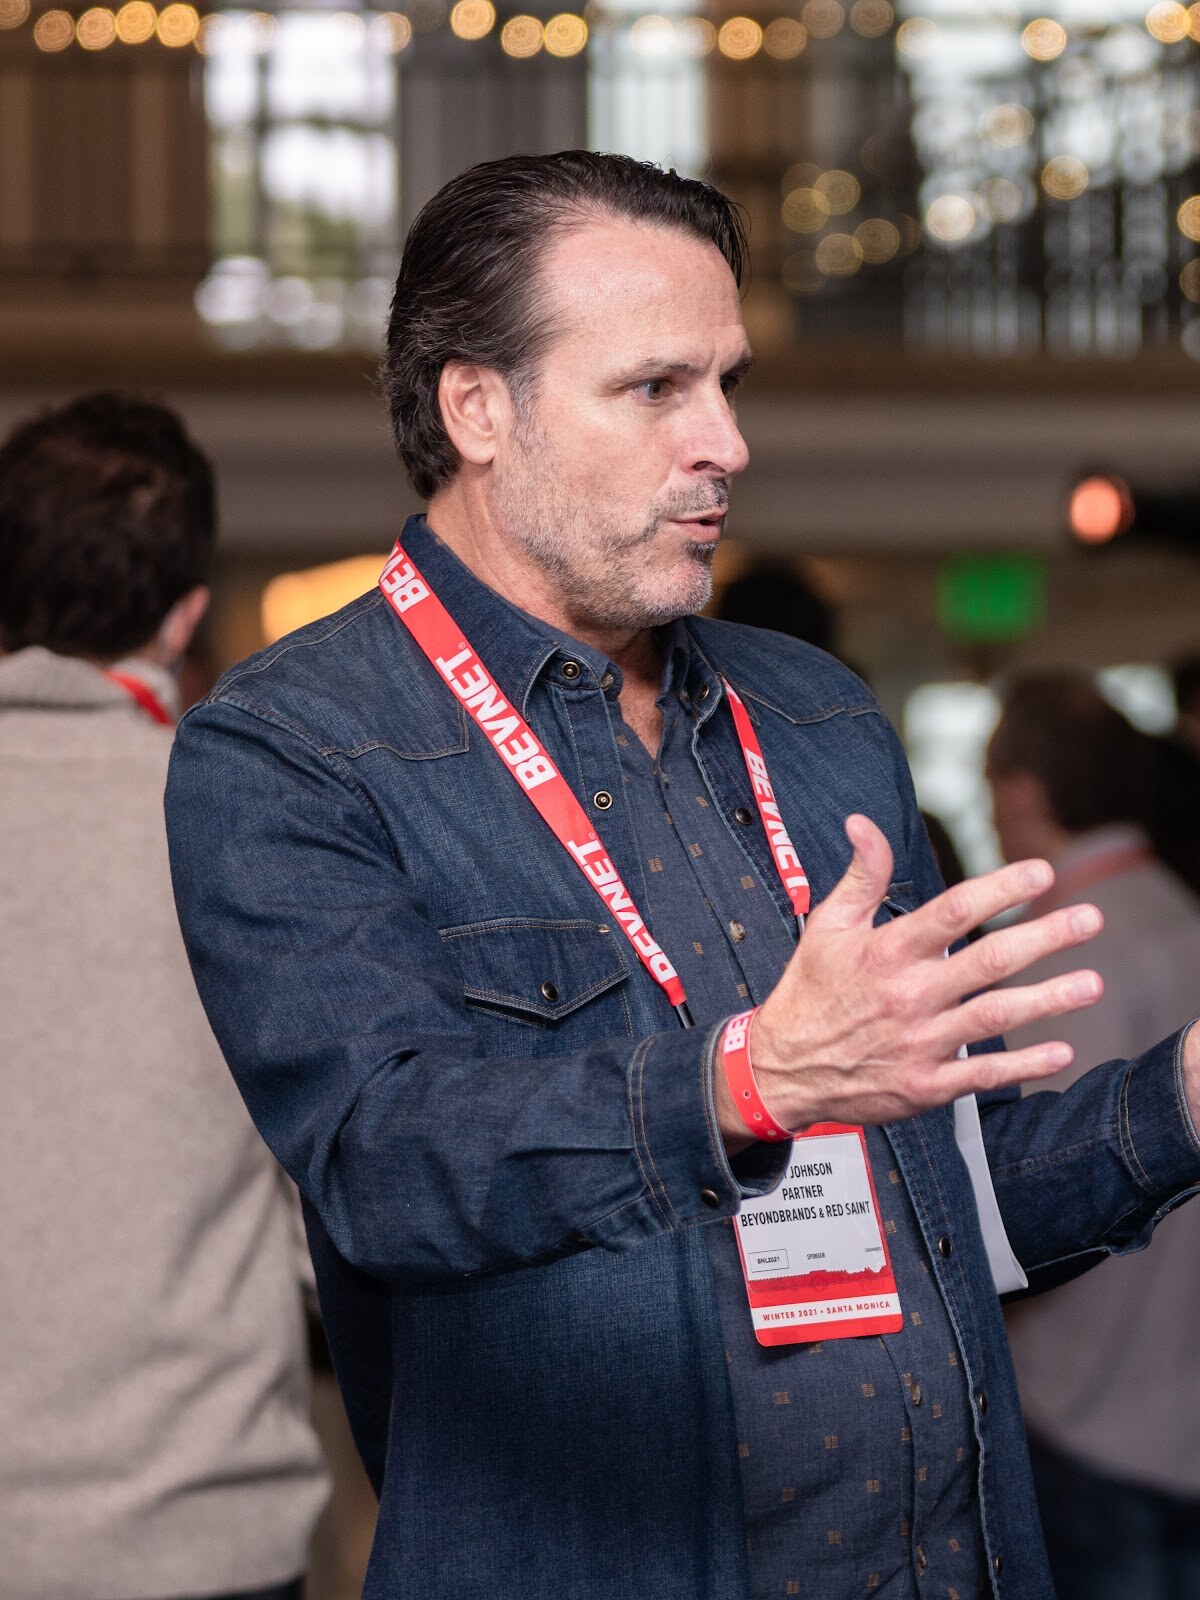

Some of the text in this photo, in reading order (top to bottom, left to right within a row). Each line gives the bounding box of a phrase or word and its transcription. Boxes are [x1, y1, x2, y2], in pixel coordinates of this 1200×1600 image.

[435, 648, 557, 790] BEVNET
[790, 1162, 833, 1179] JOHNSON
[782, 1184, 824, 1200] PARTNER
[740, 1200, 871, 1227] BEYONDBRANDS & RED SAINT
[806, 1251, 826, 1260] SPONSOR
[762, 1301, 891, 1321] WINTER 2021 SANTA MONICA
